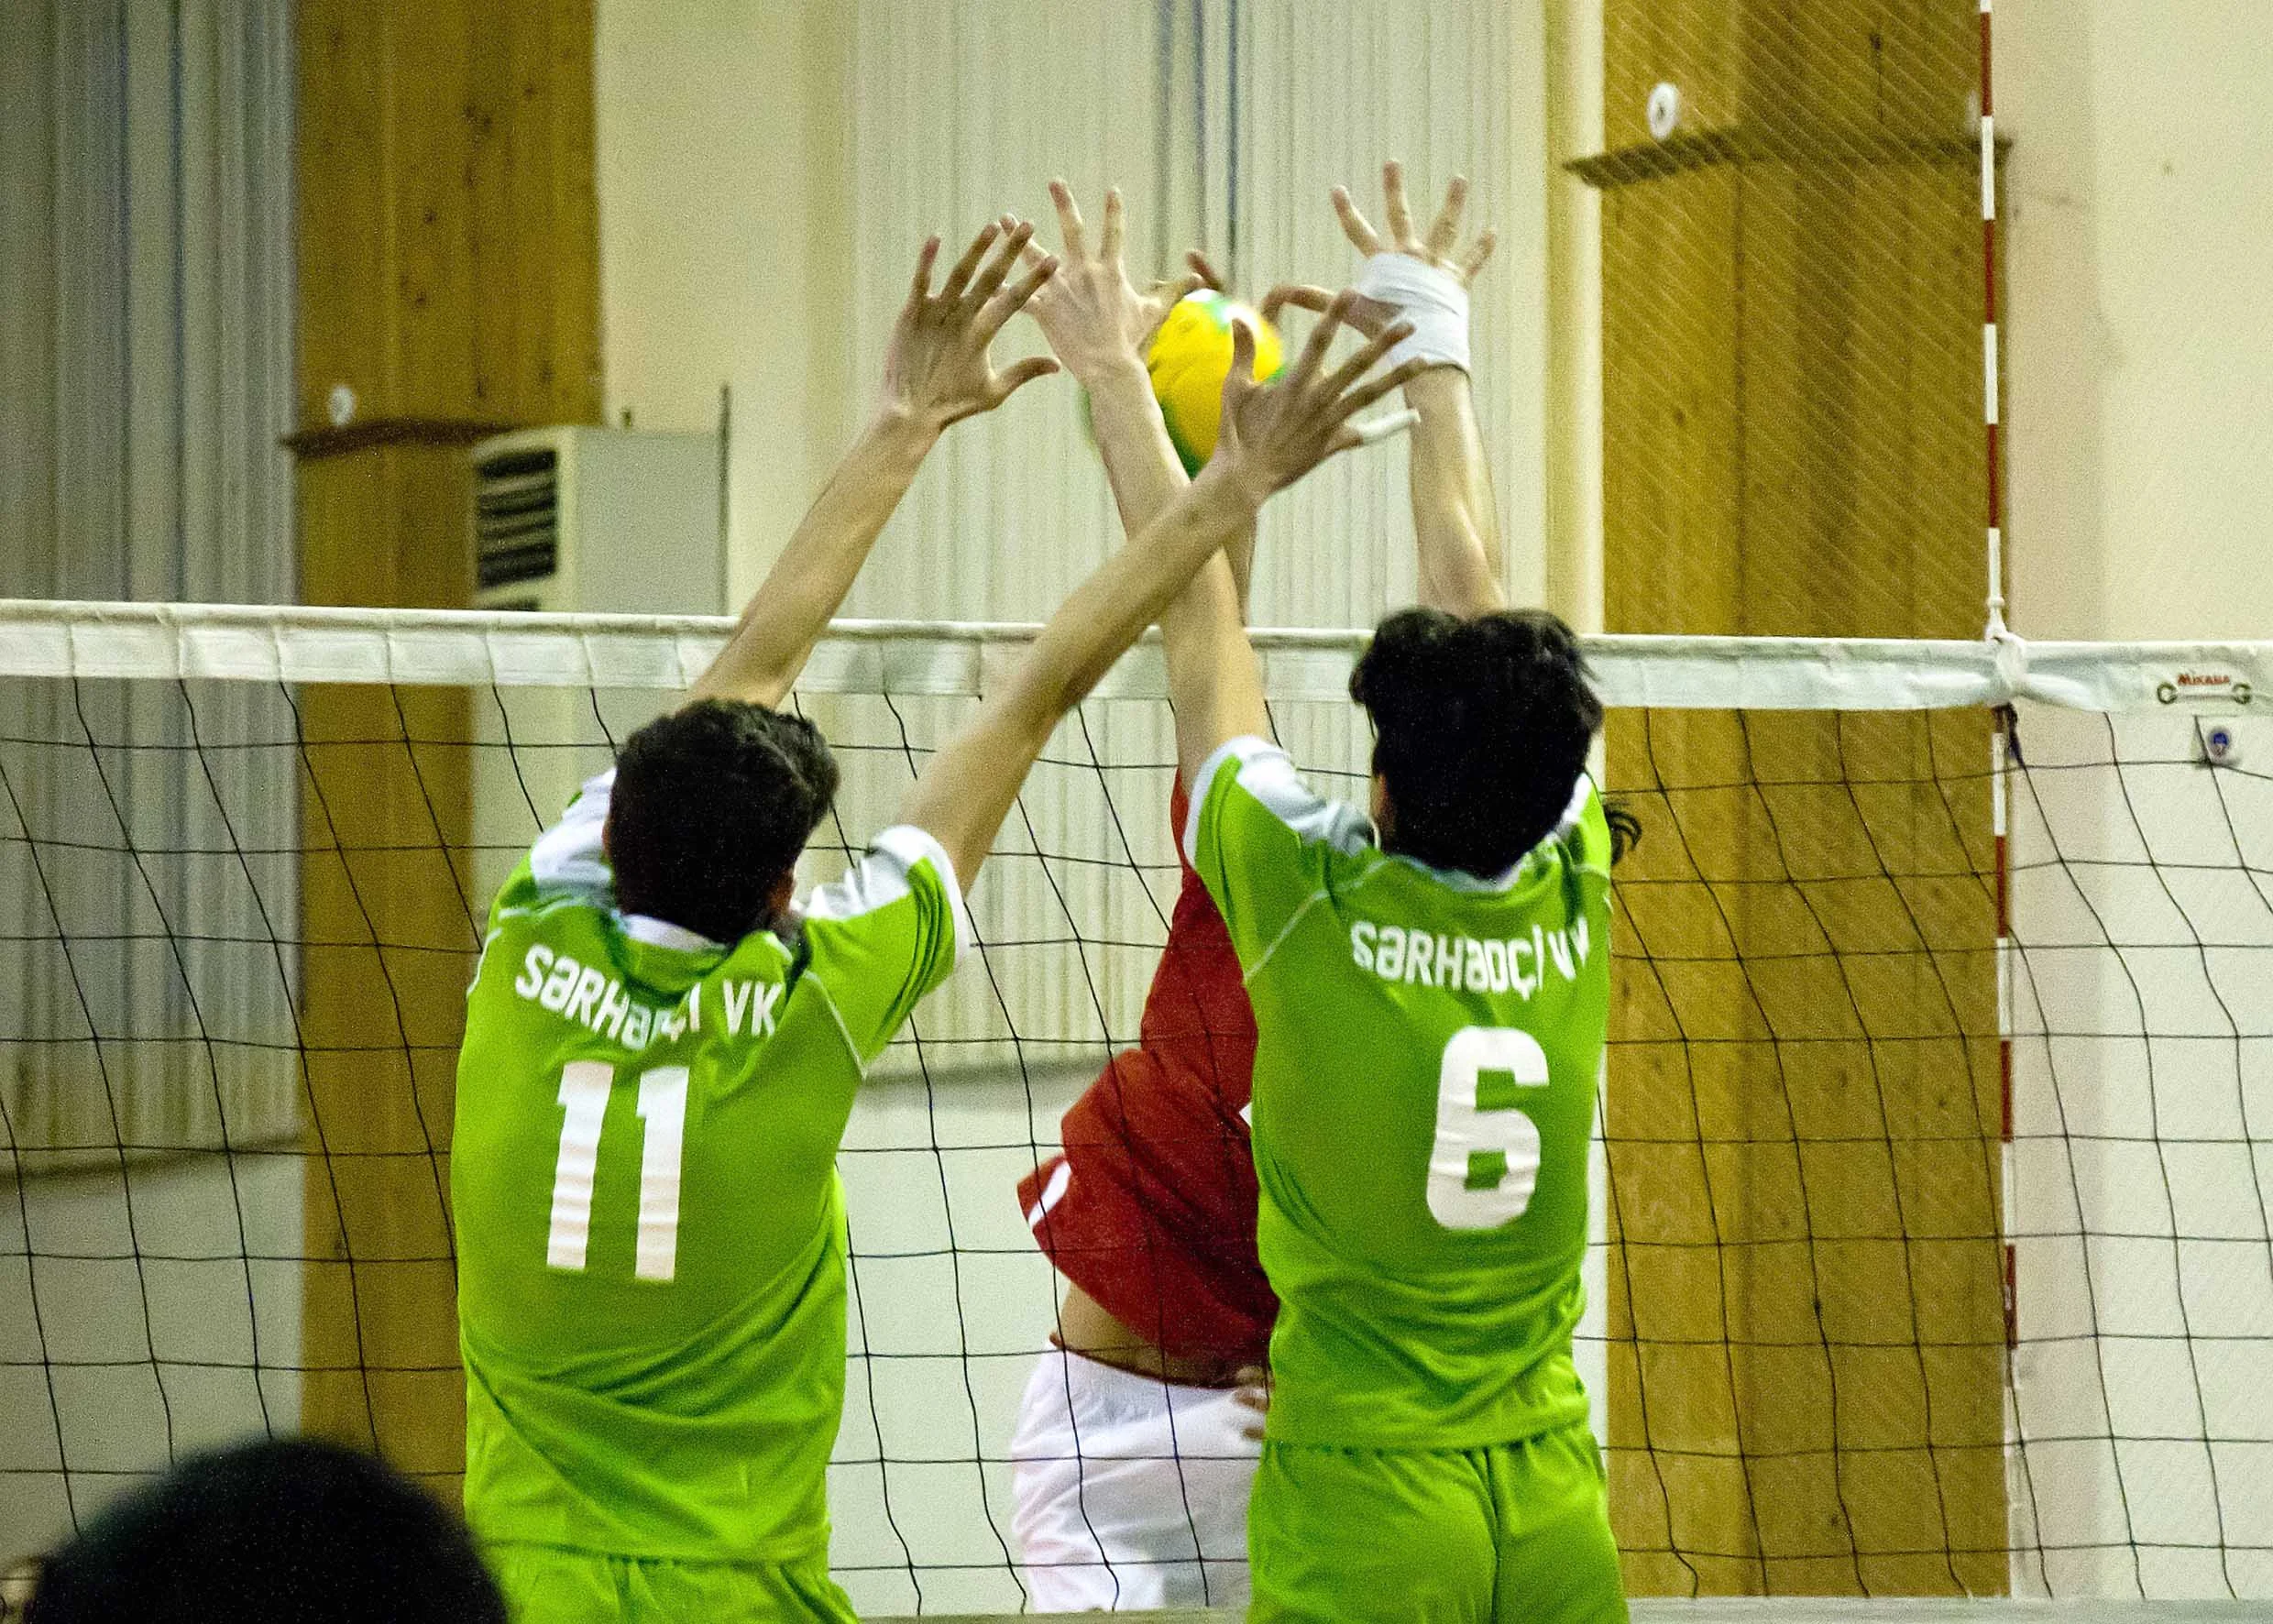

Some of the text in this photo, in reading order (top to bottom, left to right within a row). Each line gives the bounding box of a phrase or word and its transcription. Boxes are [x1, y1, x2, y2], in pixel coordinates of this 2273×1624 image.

[722, 978, 787, 1037] VK
[547, 1059, 690, 1282] 11
[1426, 1025, 1550, 1230] 6
